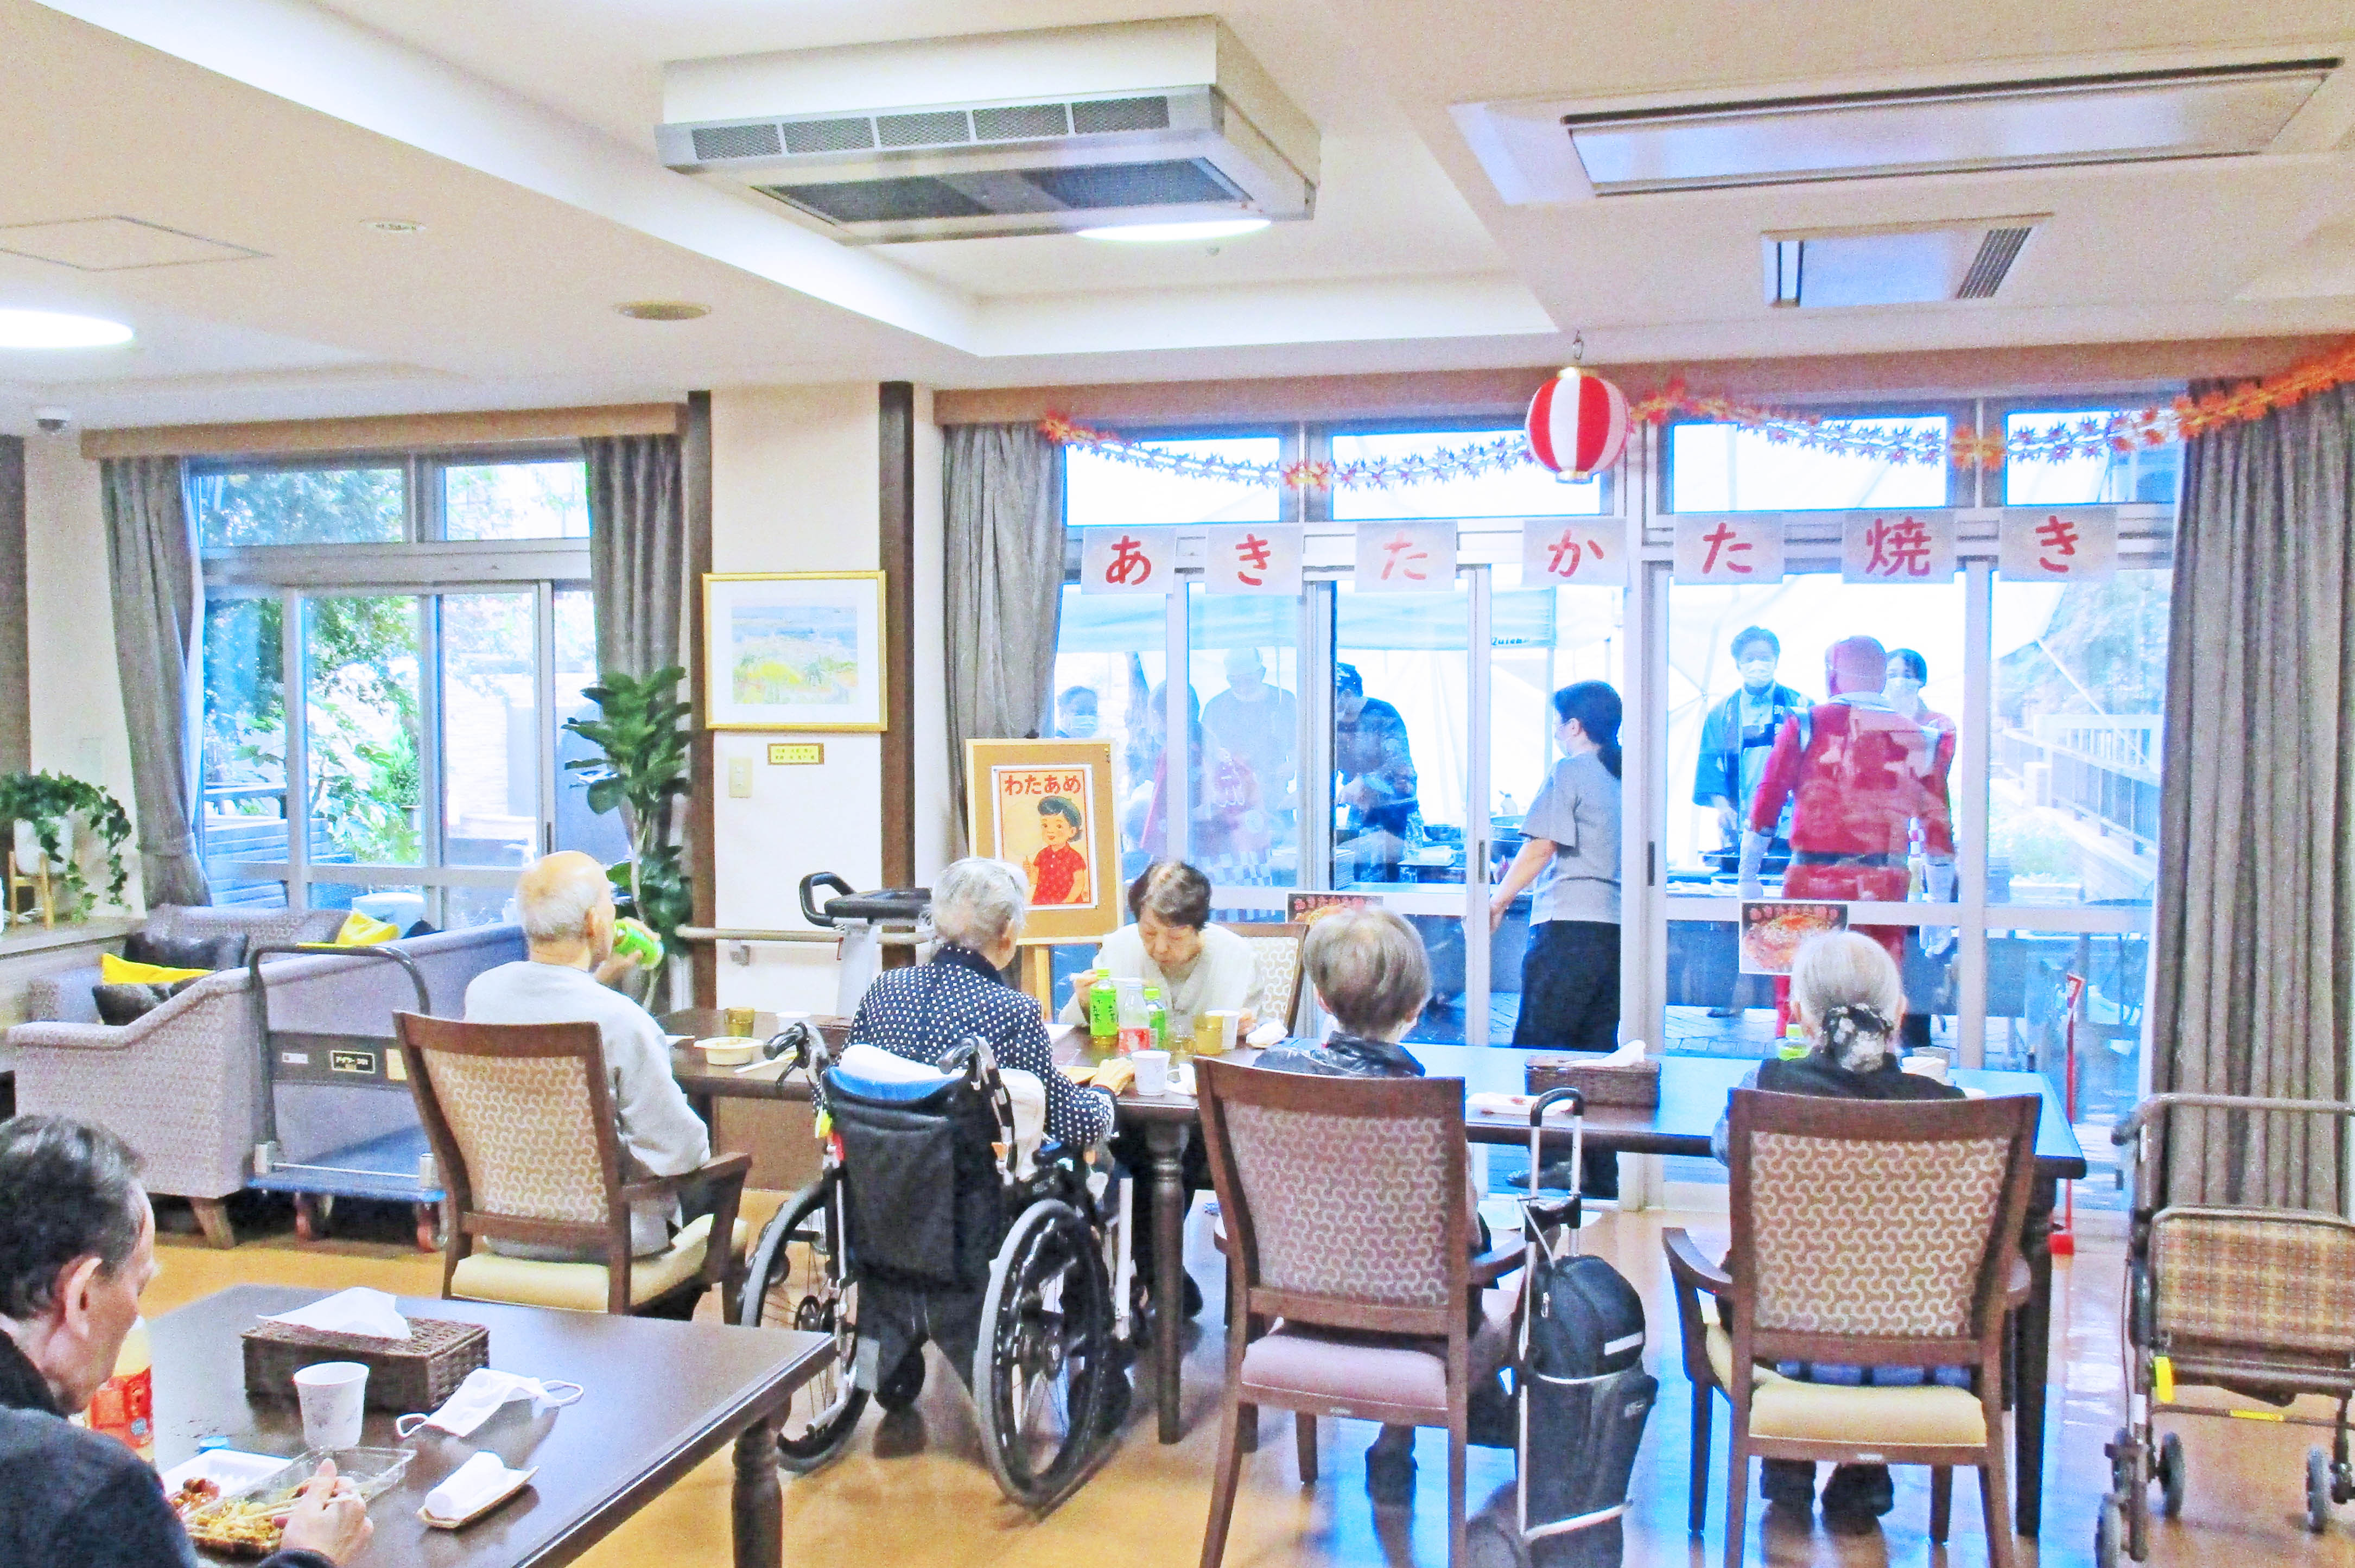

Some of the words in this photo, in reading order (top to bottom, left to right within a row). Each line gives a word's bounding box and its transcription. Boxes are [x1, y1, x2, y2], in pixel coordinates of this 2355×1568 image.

[1104, 515, 2080, 586] あきたかた焼き
[1004, 774, 1082, 796] わたあめ
